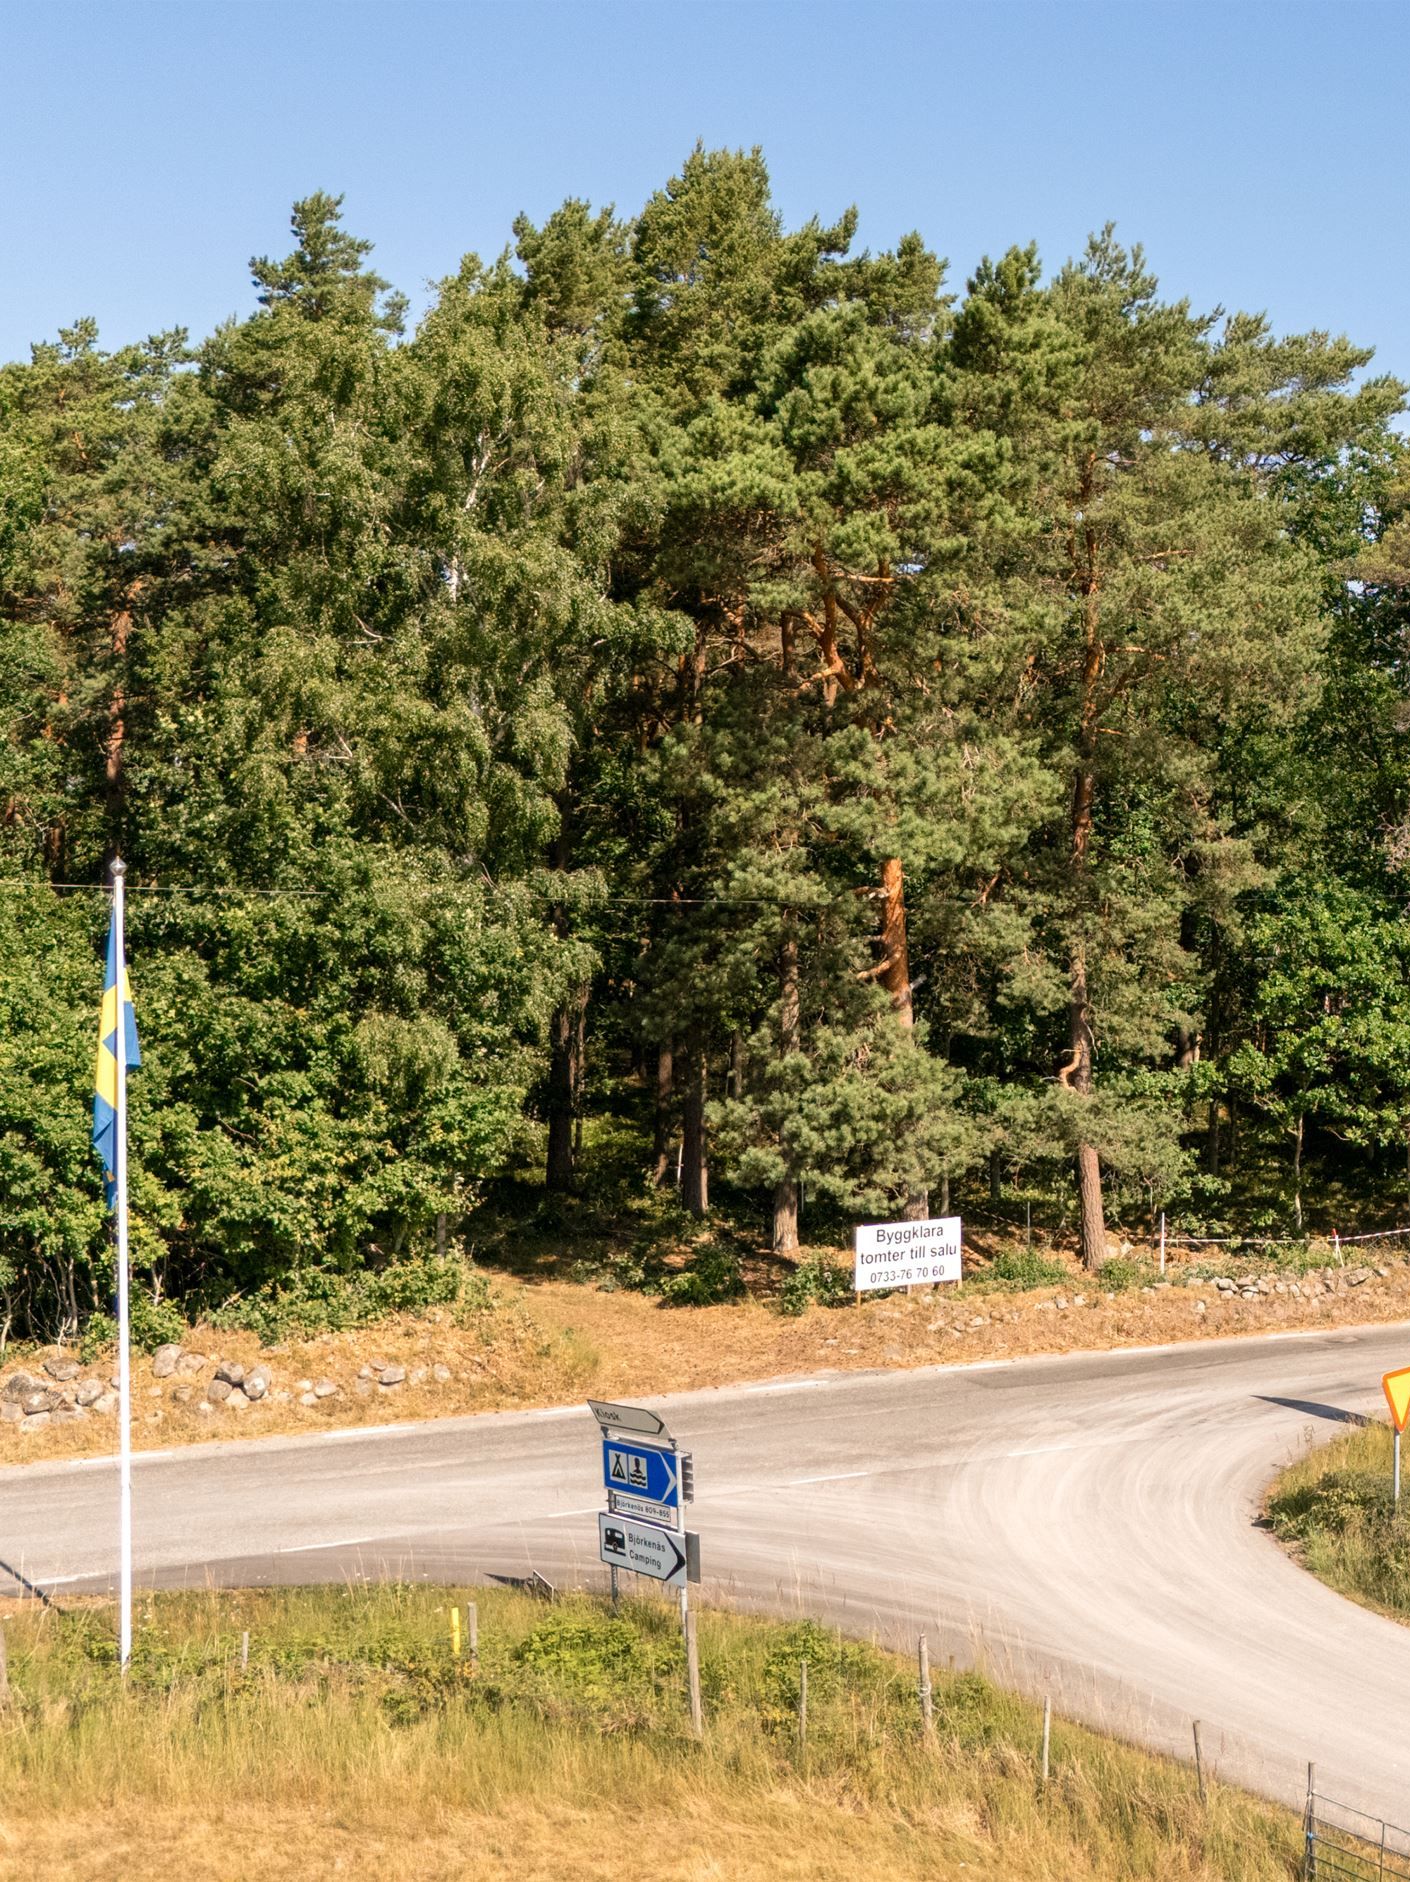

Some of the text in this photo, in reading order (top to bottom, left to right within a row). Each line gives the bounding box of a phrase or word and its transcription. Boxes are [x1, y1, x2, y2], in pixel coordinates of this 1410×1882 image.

[876, 1225, 944, 1245] Byggklara
[861, 1243, 957, 1265] tomter till salu
[870, 1265, 945, 1283] 0733-76 70 60
[594, 1407, 621, 1421] Kiosk
[628, 1532, 665, 1552] Björkenäs
[629, 1549, 661, 1570] Camping
